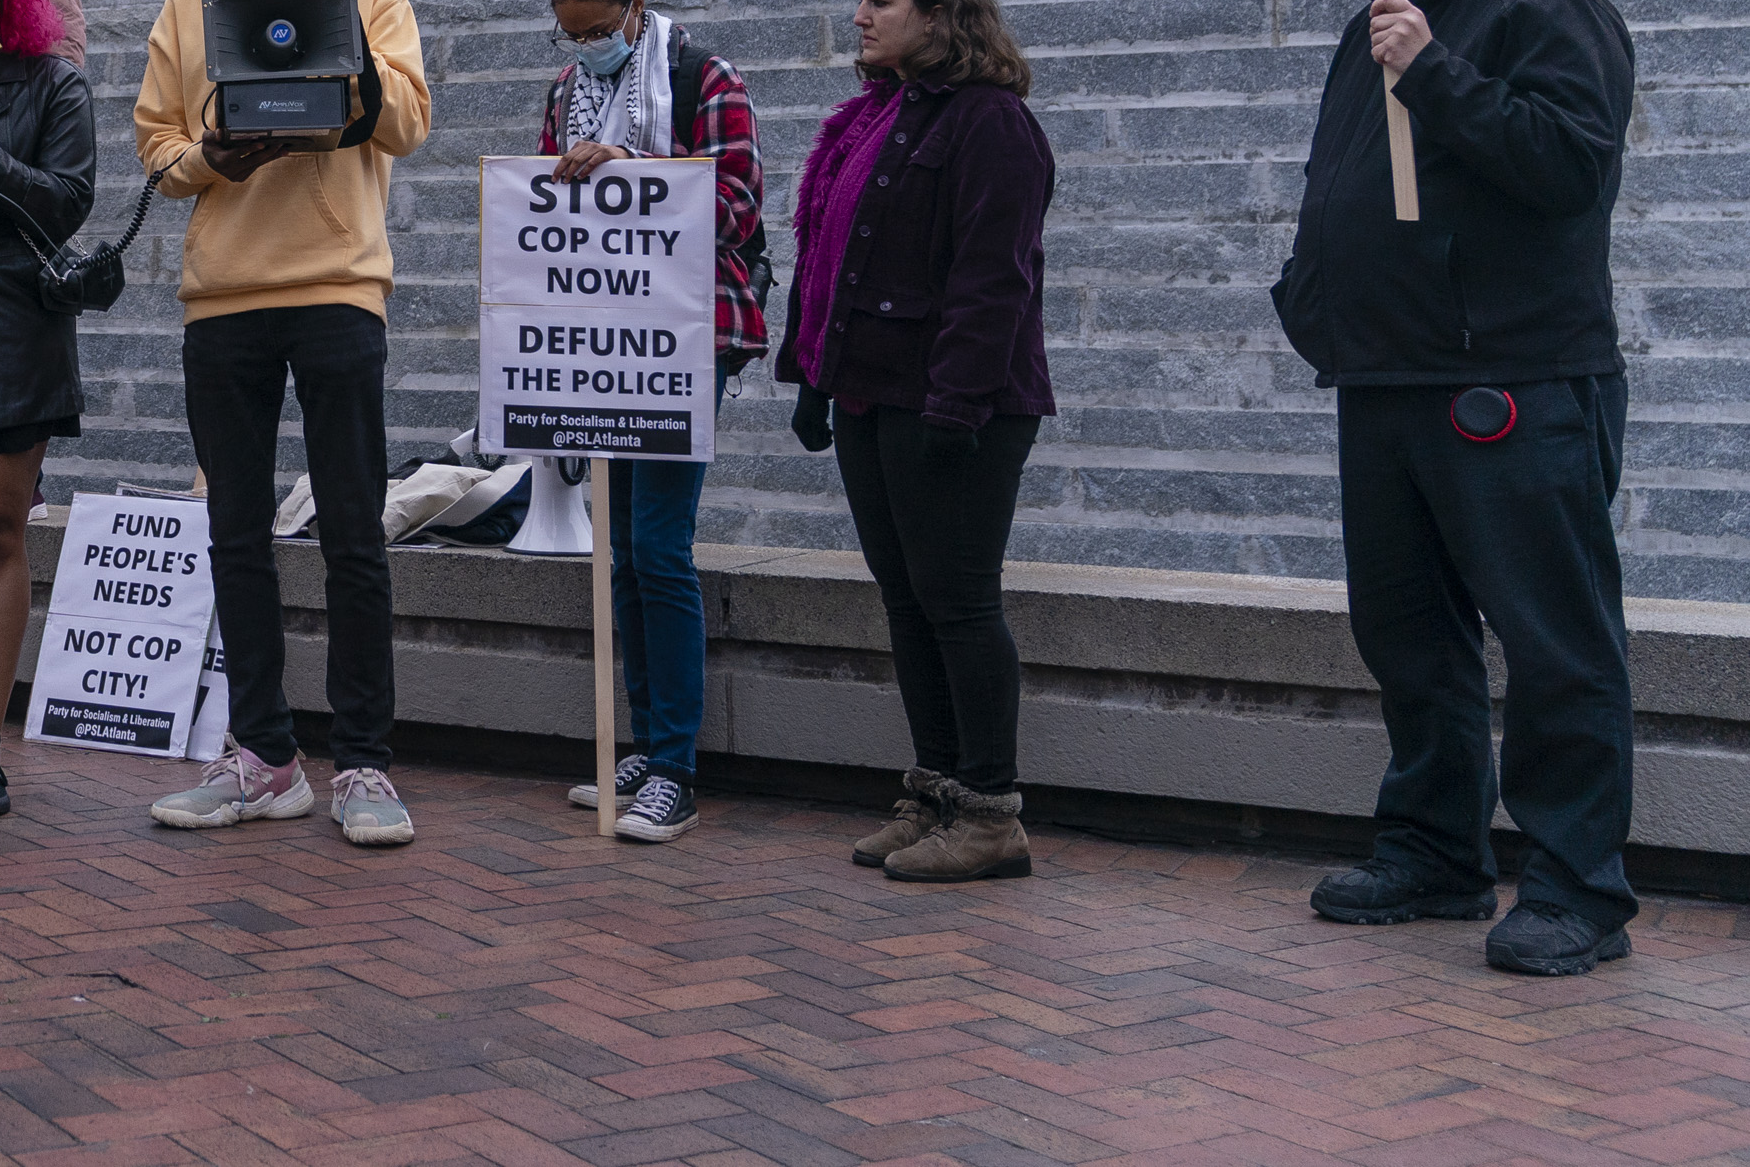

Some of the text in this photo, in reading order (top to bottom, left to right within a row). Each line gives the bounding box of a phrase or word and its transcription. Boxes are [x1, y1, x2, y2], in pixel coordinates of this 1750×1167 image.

[529, 174, 669, 216] STOP
[518, 226, 681, 256] COP CITY
[547, 267, 650, 296] NOW!
[519, 325, 677, 357] DEFUND
[502, 367, 693, 396] THE POLICE!
[509, 412, 687, 430] Party for Socialism & Liberation
[553, 432, 641, 448] @PSLAtlanta
[112, 513, 181, 538] FUND
[84, 544, 198, 575] PEOPLE'S
[93, 579, 173, 608] NEEDS
[64, 628, 121, 656] NOT
[127, 635, 182, 662] COP
[82, 669, 148, 699] CITY!
[48, 705, 170, 729] Party for Socialism & Liberation
[75, 723, 136, 741] @PSLAtlanta
